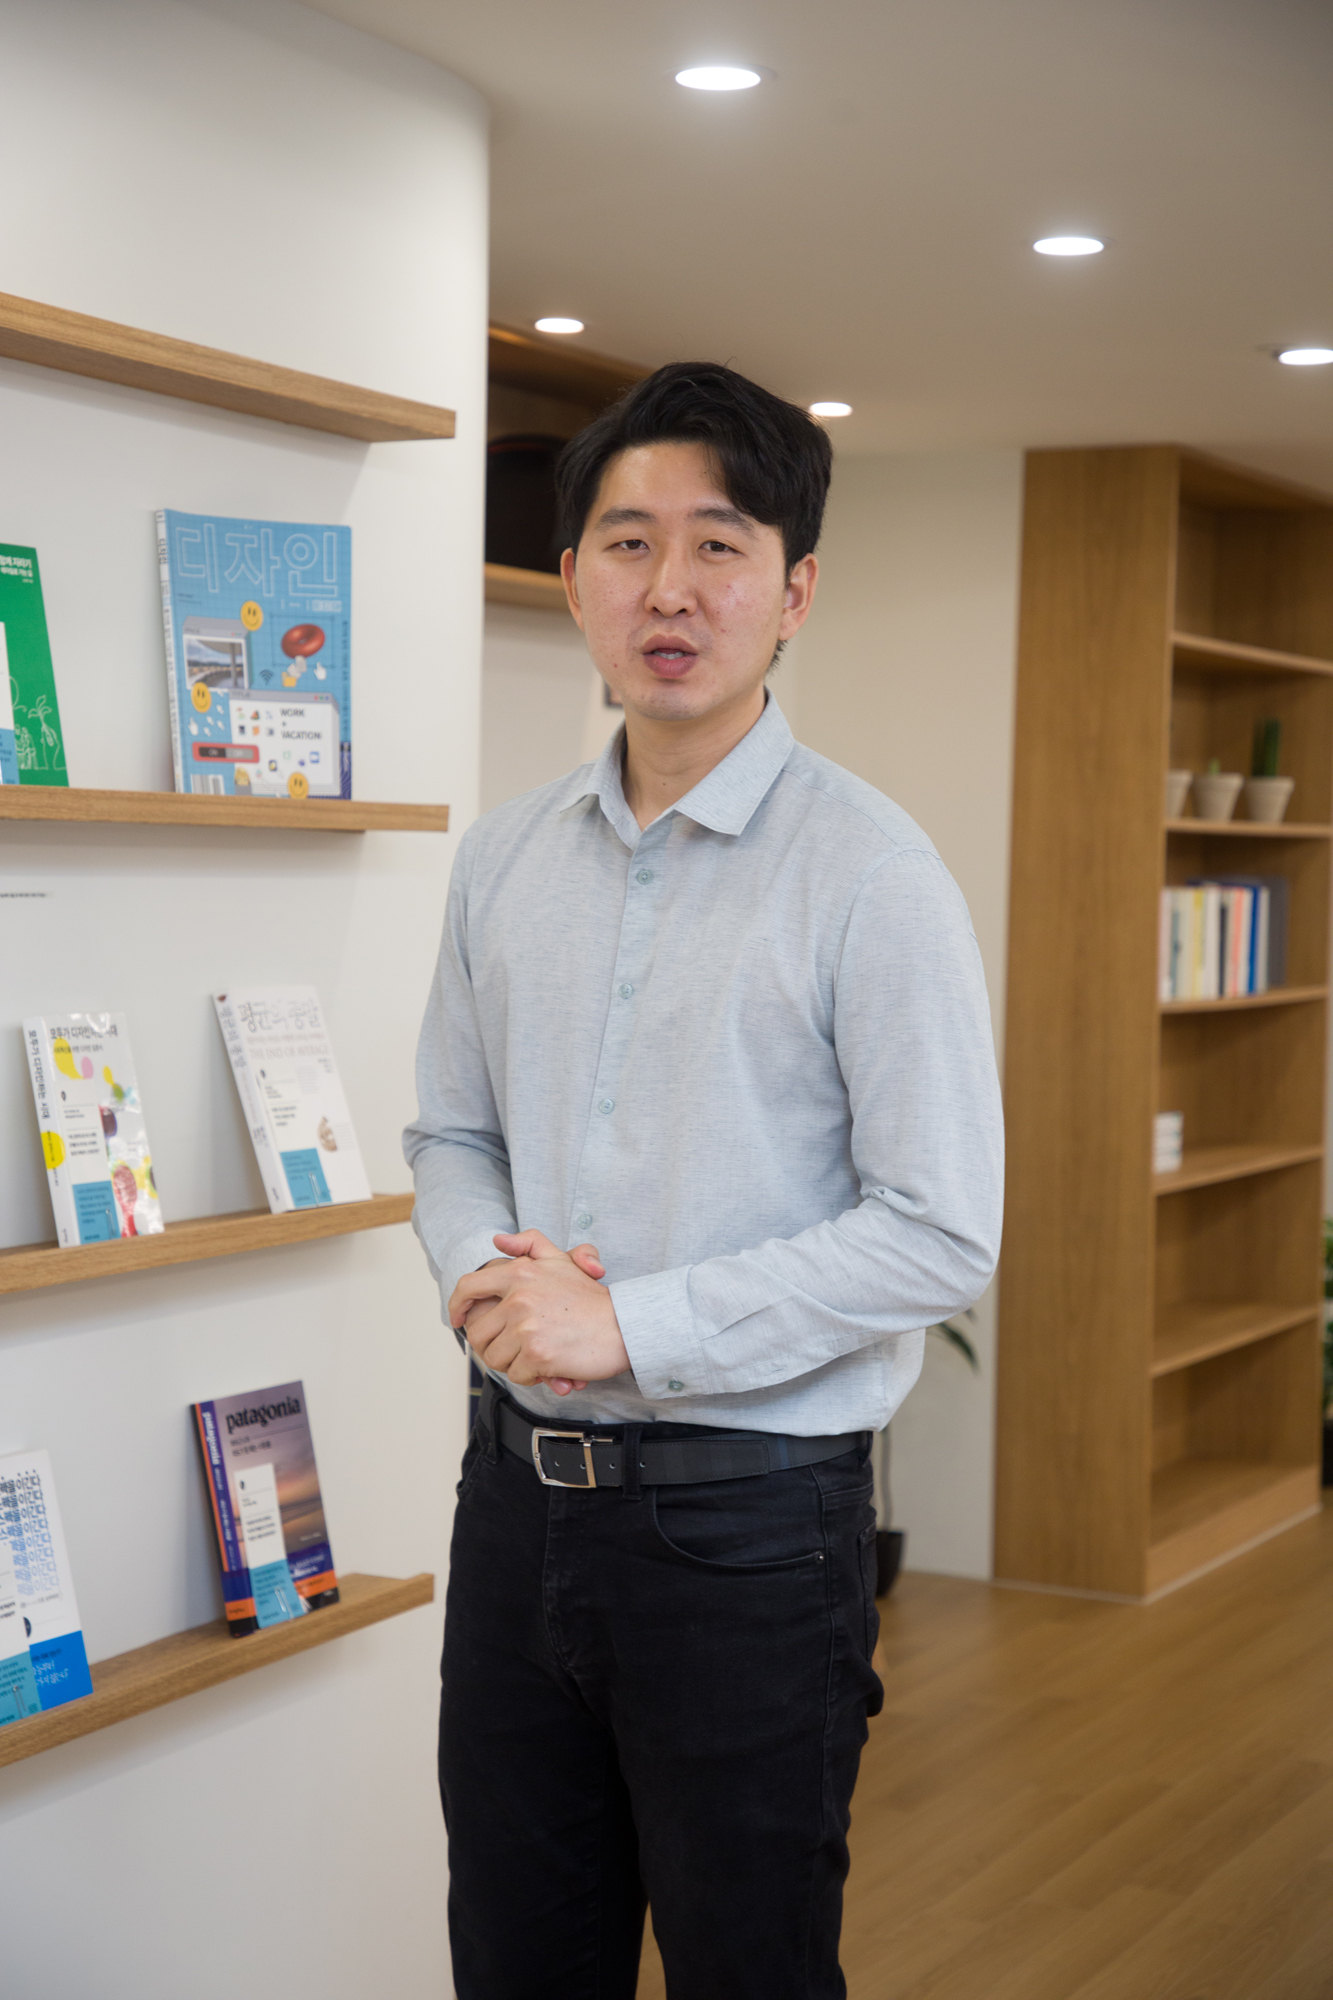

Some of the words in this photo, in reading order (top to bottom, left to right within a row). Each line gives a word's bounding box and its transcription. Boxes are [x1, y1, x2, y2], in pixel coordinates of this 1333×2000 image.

[175, 522, 339, 598] 디자인
[279, 708, 306, 718] WORK
[236, 1000, 289, 1034] 평균의
[249, 1048, 265, 1061] THE
[265, 1048, 283, 1060] END
[283, 1046, 296, 1059] OF
[296, 1043, 330, 1058] AVERAGE
[225, 1396, 302, 1435] patagonia
[16, 1474, 41, 1491] 이긴다
[18, 1488, 44, 1505] 이긴다
[20, 1503, 46, 1519] 이긴다
[23, 1517, 49, 1534] 이긴다
